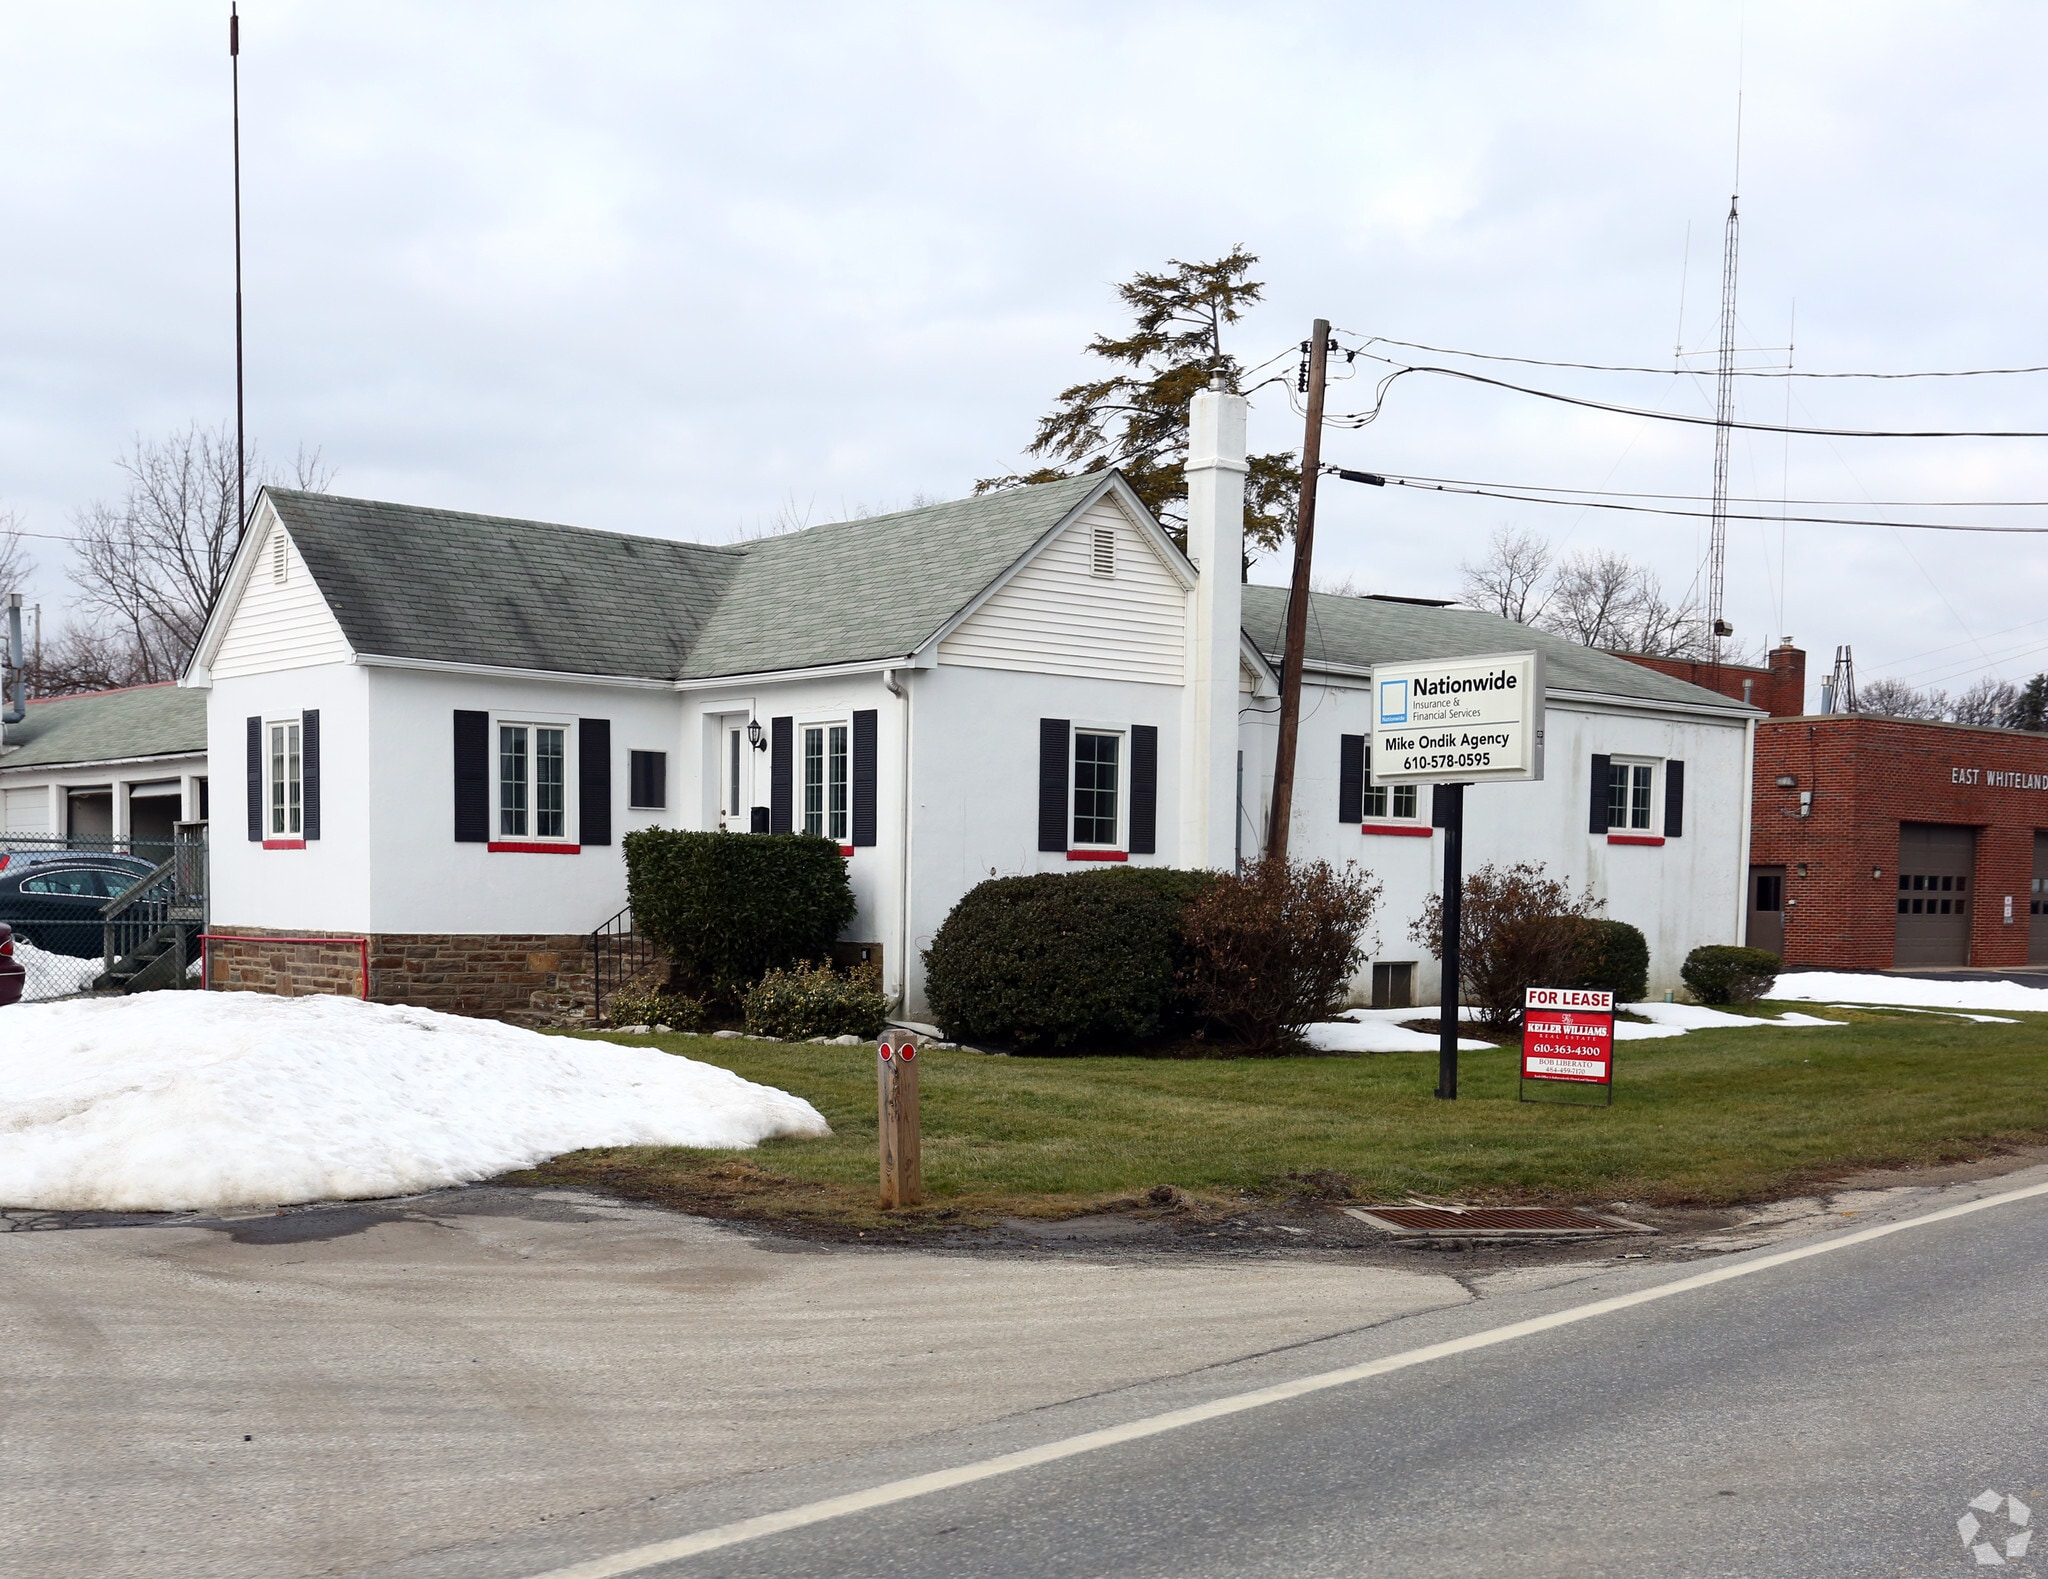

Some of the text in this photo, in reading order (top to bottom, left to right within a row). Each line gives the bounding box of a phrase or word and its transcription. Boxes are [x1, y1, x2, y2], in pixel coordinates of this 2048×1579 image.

[1413, 670, 1517, 697] Nationwide
[1413, 697, 1460, 710] Insurance &
[1413, 708, 1481, 721] Financial Services
[1385, 733, 1509, 751] Mike Ondik Agency
[1404, 752, 1490, 770] 610-578-0595
[1952, 768, 2048, 790] EAST WHITELAND
[1529, 991, 1609, 1007] FOR LEASE
[1527, 1023, 1561, 1034] KELLER
[1533, 1044, 1600, 1056] 610-363-4300
[1556, 1060, 1593, 1068] LIBERATO
